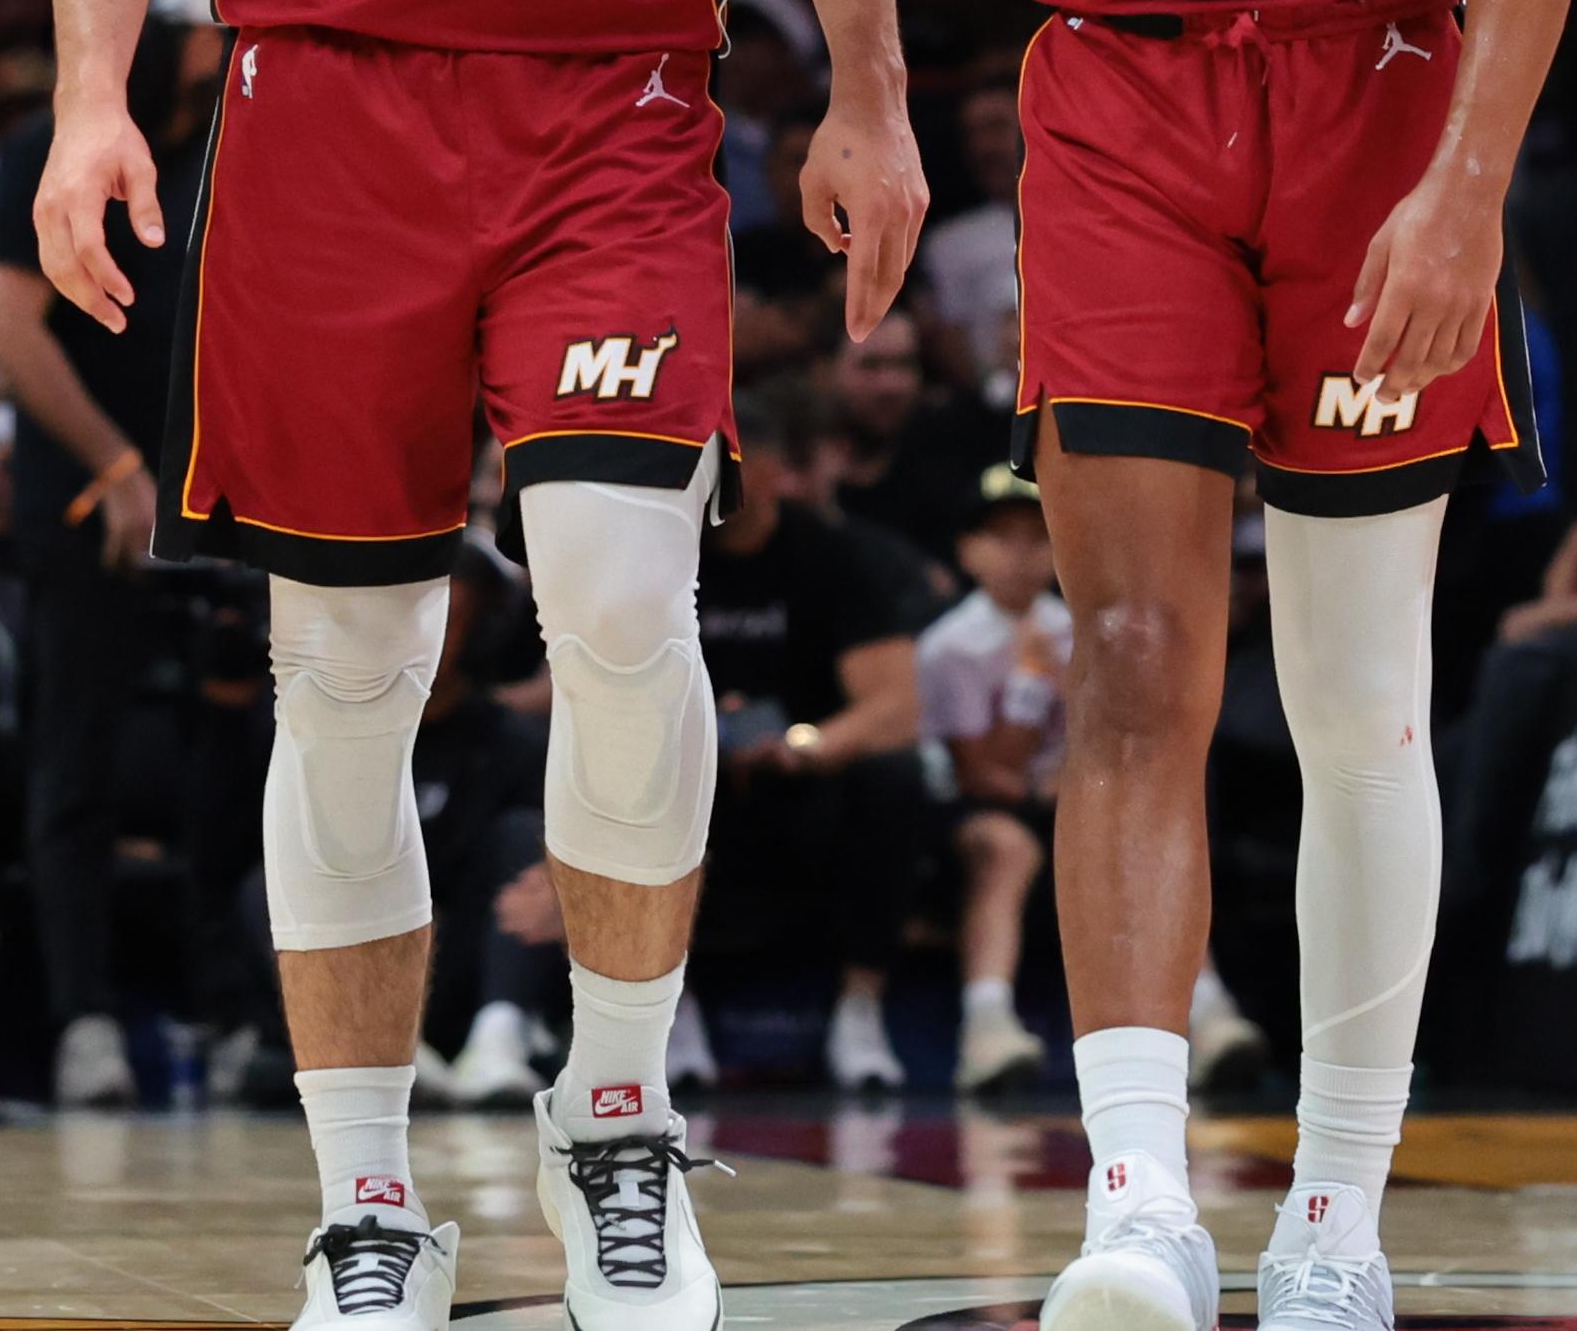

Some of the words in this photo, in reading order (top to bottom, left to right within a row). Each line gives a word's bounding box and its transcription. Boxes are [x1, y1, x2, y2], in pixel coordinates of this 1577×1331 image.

[600, 1089, 626, 1104] NIKE
[620, 1101, 638, 1113] AIR
[363, 1178, 390, 1191] NIKE
[383, 1191, 401, 1203] AIR
